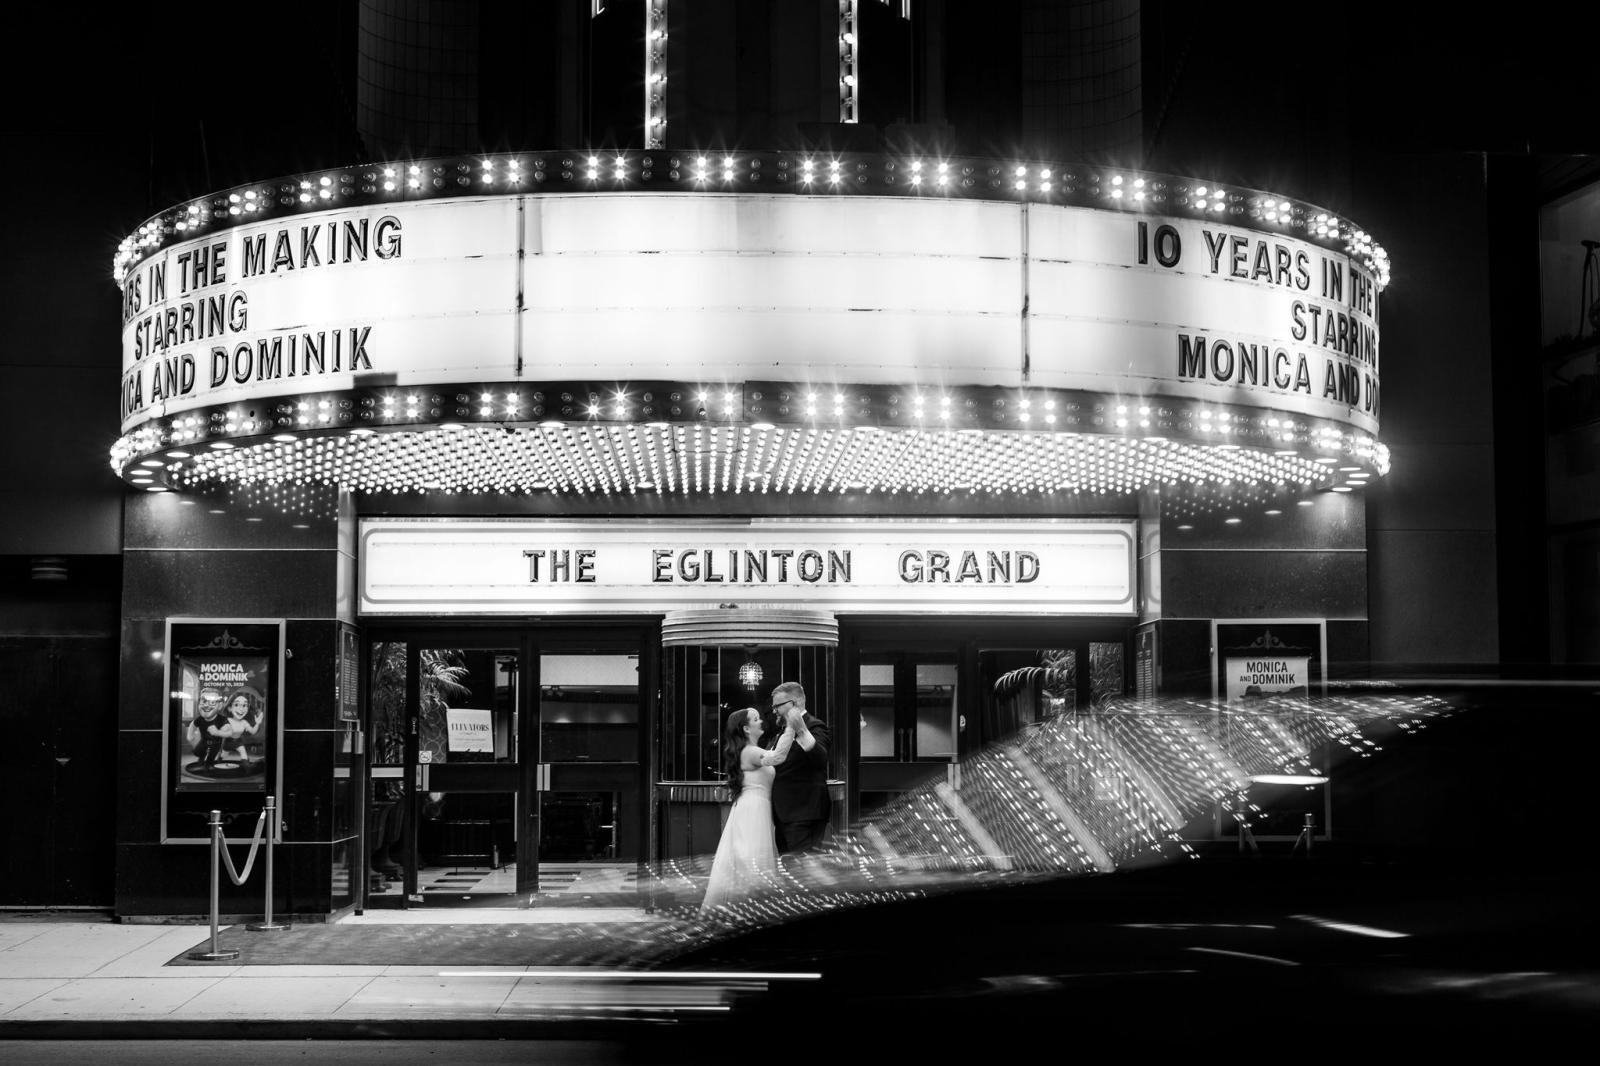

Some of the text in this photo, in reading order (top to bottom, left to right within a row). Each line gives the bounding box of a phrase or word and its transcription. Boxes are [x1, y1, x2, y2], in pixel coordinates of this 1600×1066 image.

[149, 261, 166, 305] IN
[178, 242, 227, 293] THE
[242, 215, 402, 278] MAKING
[1137, 221, 1182, 269] 10
[1202, 230, 1311, 291] YEARS
[1322, 257, 1343, 302] IN
[1351, 267, 1372, 319] THE
[134, 290, 248, 361] STARRING
[1291, 300, 1376, 370] STARRING
[151, 353, 195, 404] AND
[210, 326, 373, 388] DOMINIK
[1178, 334, 1312, 394] MONICA
[1323, 359, 1360, 406] AND
[523, 549, 1040, 583] THE EGLINTON GRAND
[201, 663, 244, 673] MONICA
[205, 673, 249, 681] DOMINIK
[1246, 661, 1288, 673] MONICA
[1252, 674, 1296, 685] DOMINIK
